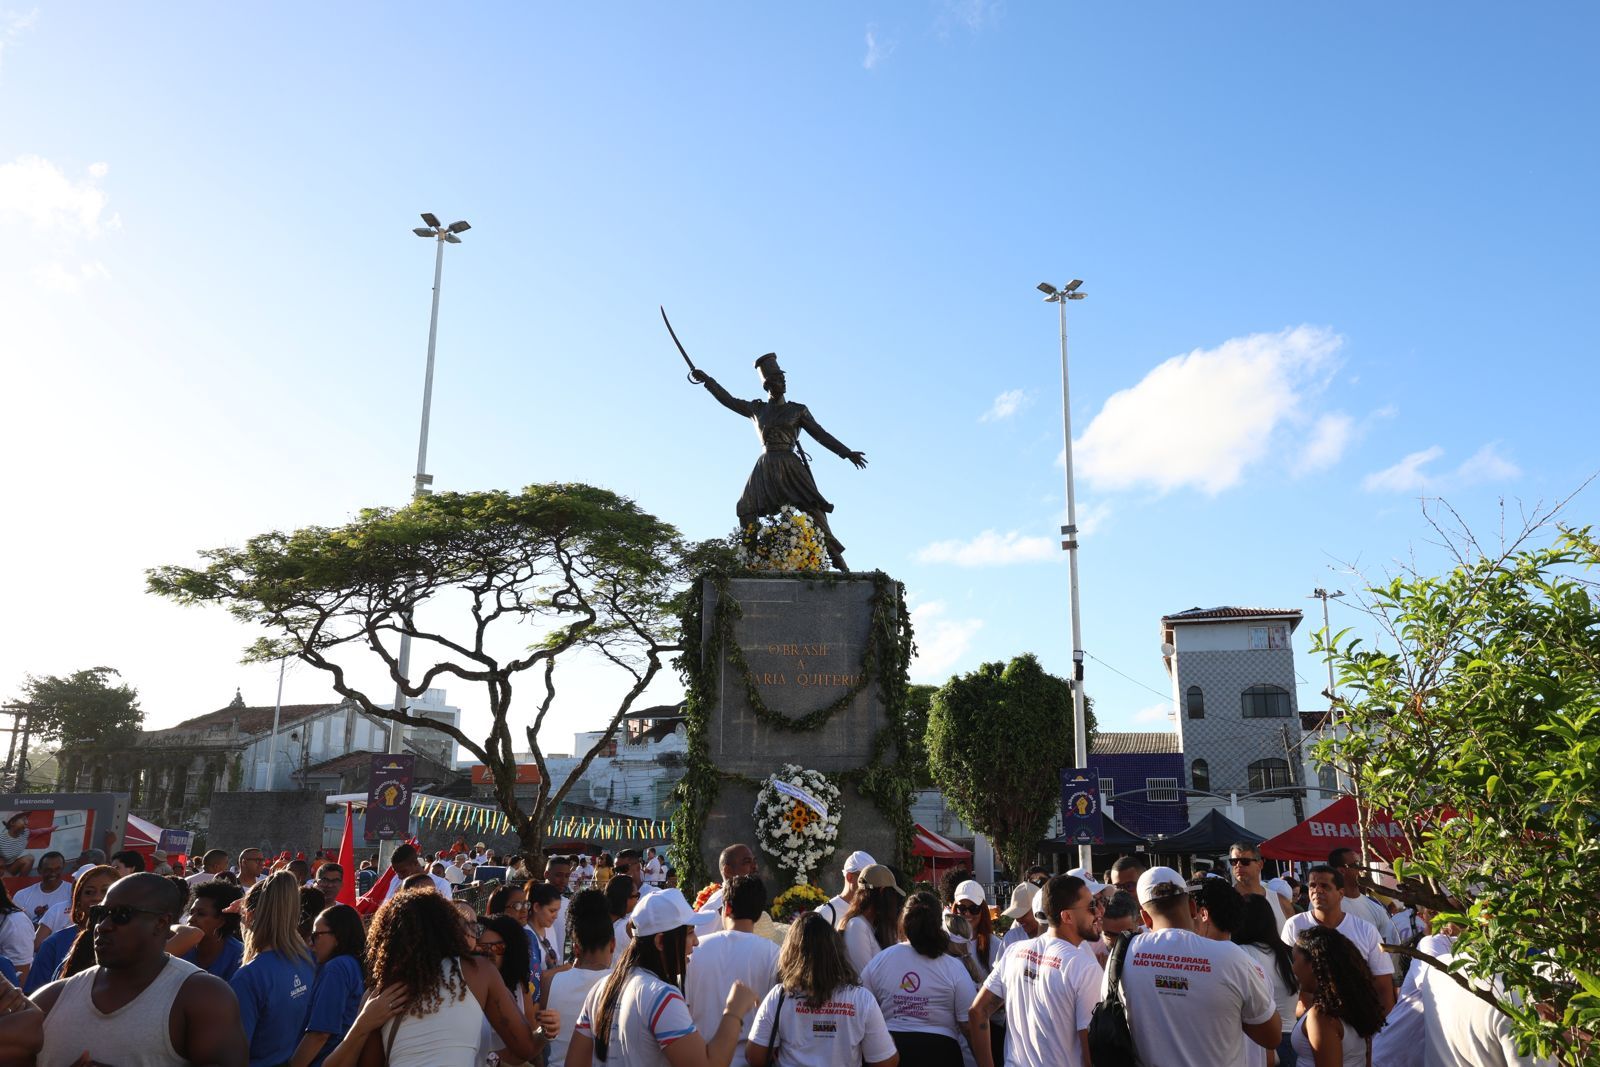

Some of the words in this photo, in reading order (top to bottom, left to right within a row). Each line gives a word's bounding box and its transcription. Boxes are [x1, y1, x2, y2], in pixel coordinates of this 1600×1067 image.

[768, 644, 779, 656] O
[783, 644, 829, 656] BRASIL
[798, 659, 805, 670] A
[1141, 952, 1166, 960] BAHIA
[1181, 956, 1210, 965] BRASIL
[1151, 960, 1183, 970] VOLTAM
